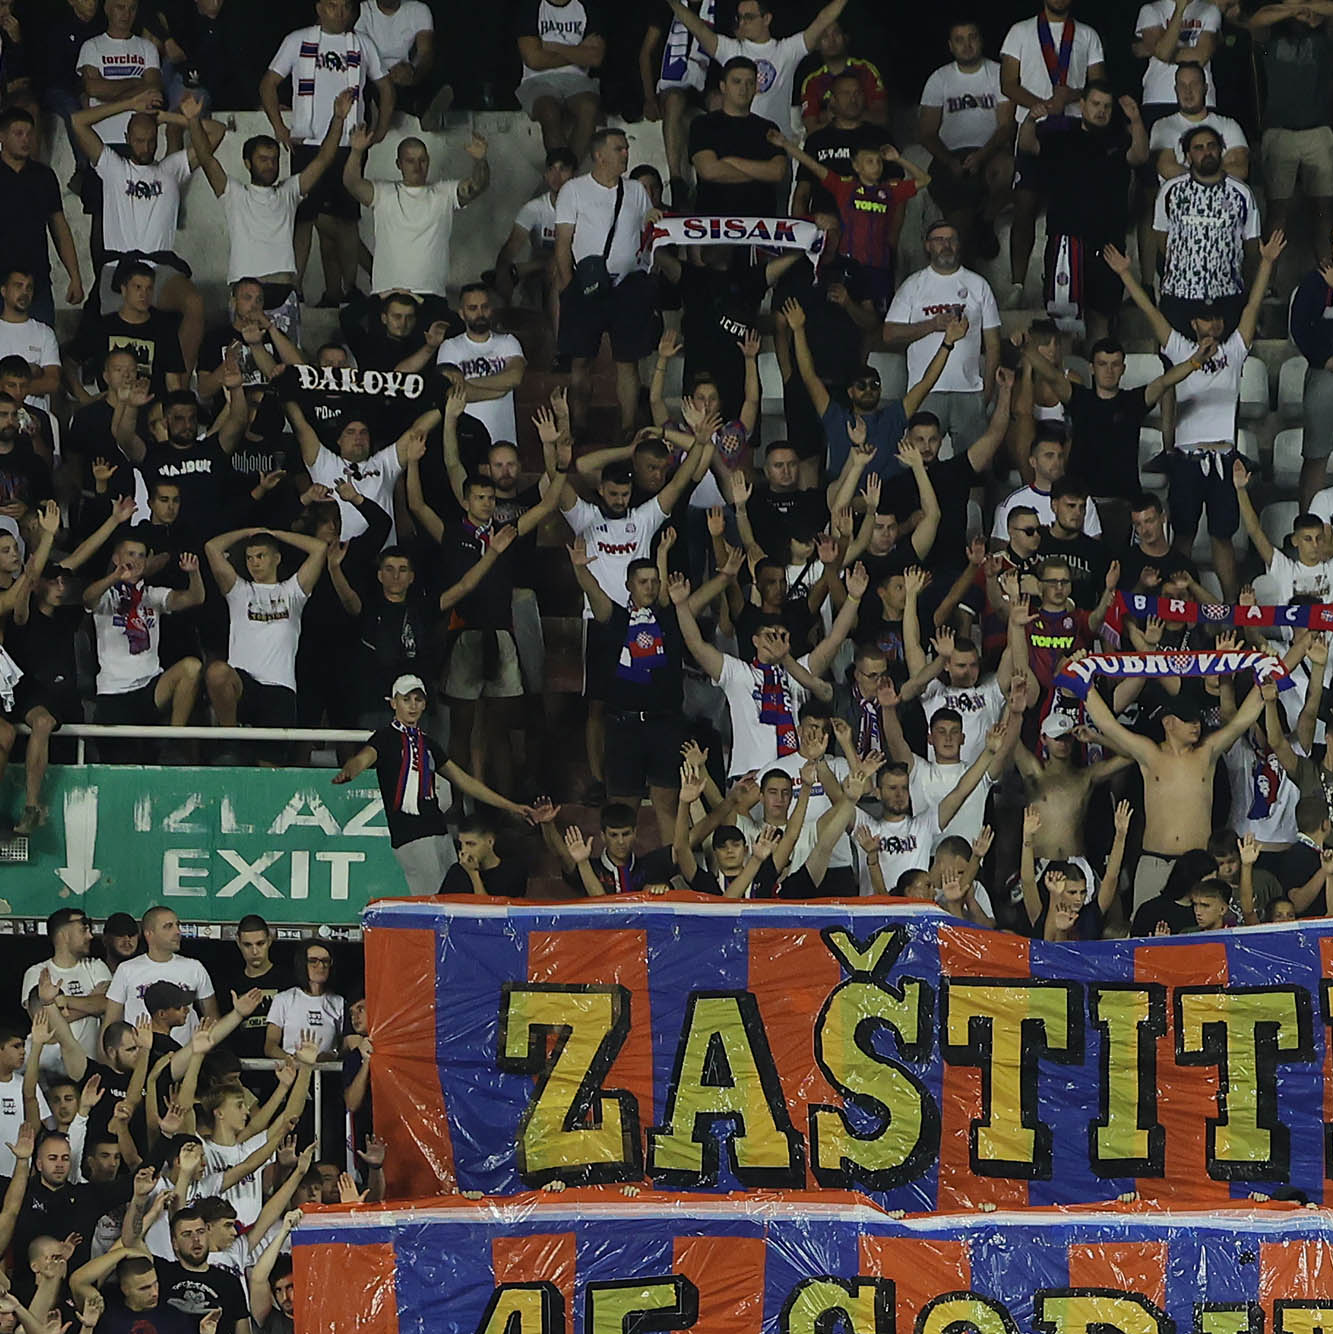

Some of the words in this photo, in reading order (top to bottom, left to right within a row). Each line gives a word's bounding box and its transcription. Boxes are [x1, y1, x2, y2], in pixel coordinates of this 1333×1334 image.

[682, 217, 799, 243] SISAK
[300, 363, 425, 399] ĐAKOVO
[597, 540, 639, 555] TOMMY
[1031, 634, 1075, 649] TOMMY
[133, 786, 392, 837] IZLAZ
[162, 849, 366, 900] EXIT
